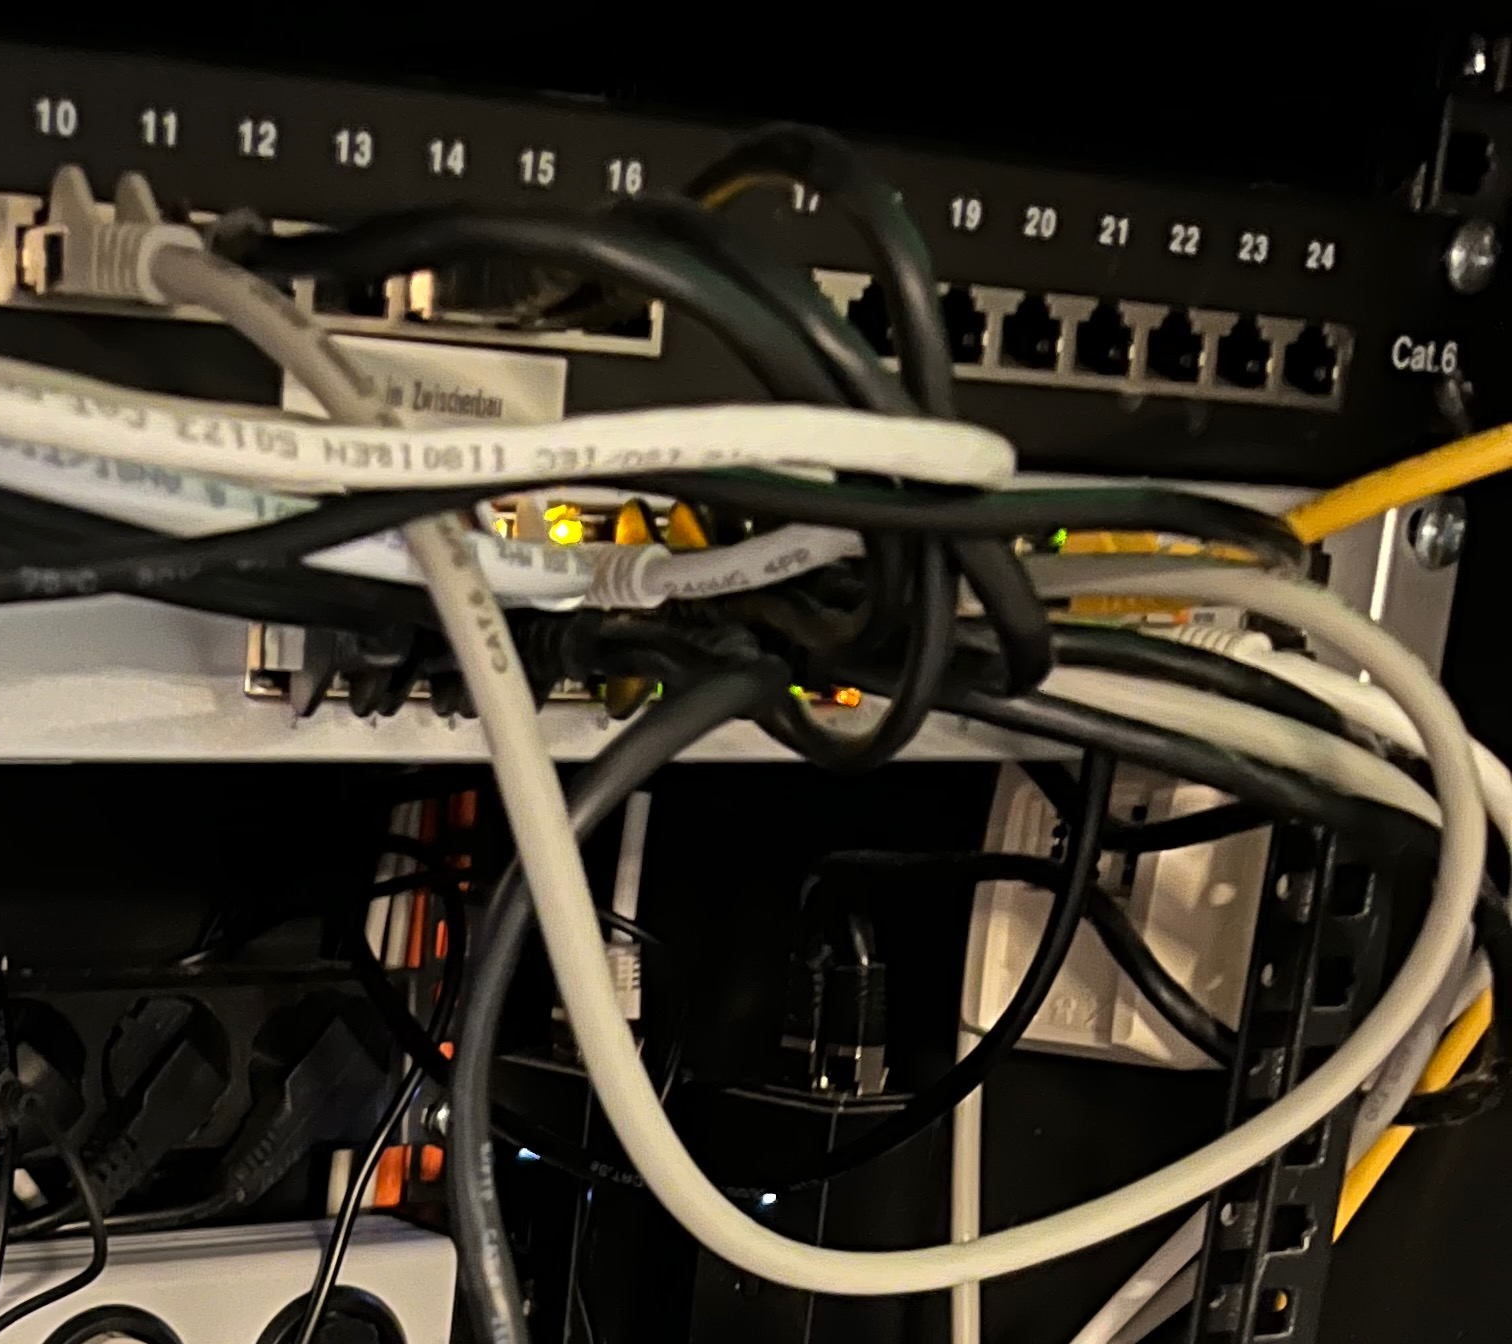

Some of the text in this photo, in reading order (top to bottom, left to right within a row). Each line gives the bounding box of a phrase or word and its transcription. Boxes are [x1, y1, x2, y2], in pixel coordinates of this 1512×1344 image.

[36, 98, 78, 136] 10
[141, 110, 178, 147] 11
[238, 121, 278, 157] 12
[335, 130, 373, 167] 13
[430, 140, 466, 176] 14
[520, 150, 556, 186] 15
[609, 160, 643, 196] 16
[951, 198, 983, 231] 19
[1024, 206, 1058, 239] 20
[1098, 215, 1130, 246] 21
[1169, 224, 1200, 255] 22
[1238, 232, 1269, 263] 23
[1306, 241, 1336, 270] 24
[1391, 335, 1459, 374] Cat.6
